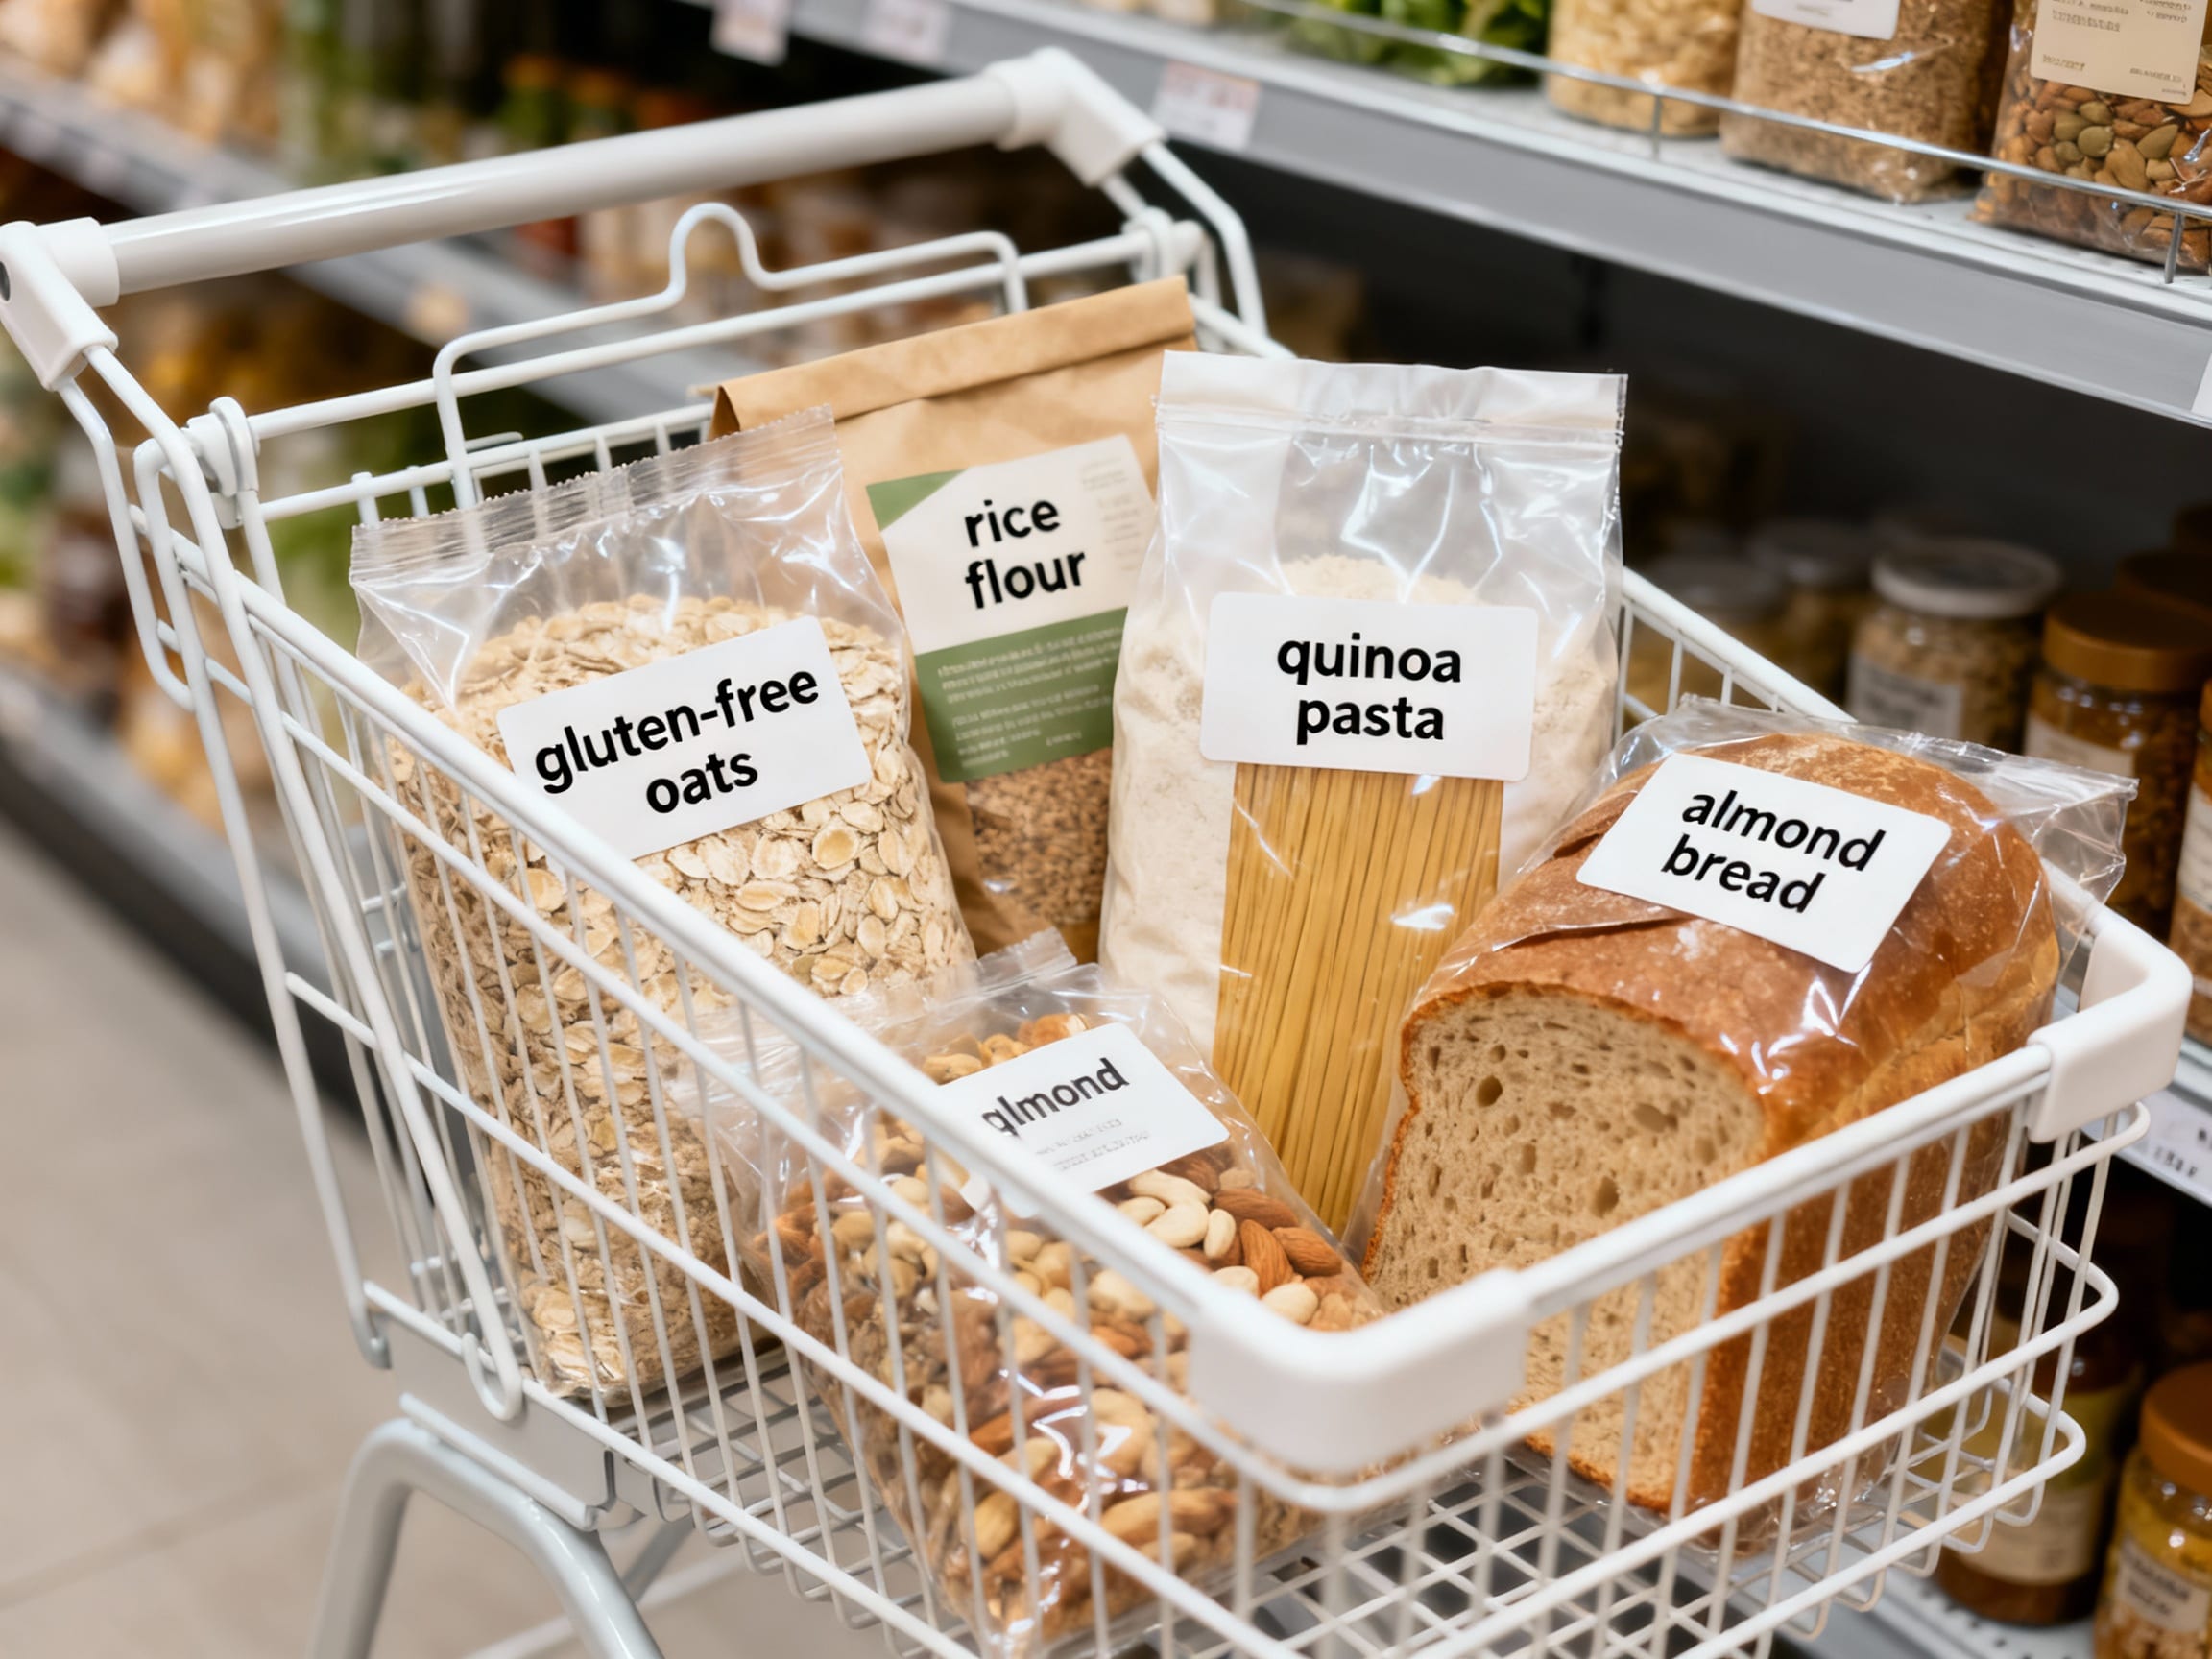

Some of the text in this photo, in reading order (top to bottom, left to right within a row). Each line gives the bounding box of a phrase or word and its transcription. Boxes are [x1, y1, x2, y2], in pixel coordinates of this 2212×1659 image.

[964, 499, 1061, 548] rice
[965, 552, 1086, 610] flour
[1277, 632, 1461, 685] quinoa
[535, 670, 819, 795] gluten-free
[1296, 697, 1444, 746] pasta
[646, 753, 758, 814] oats
[1682, 789, 1887, 872] almond
[1661, 833, 1826, 913] bread
